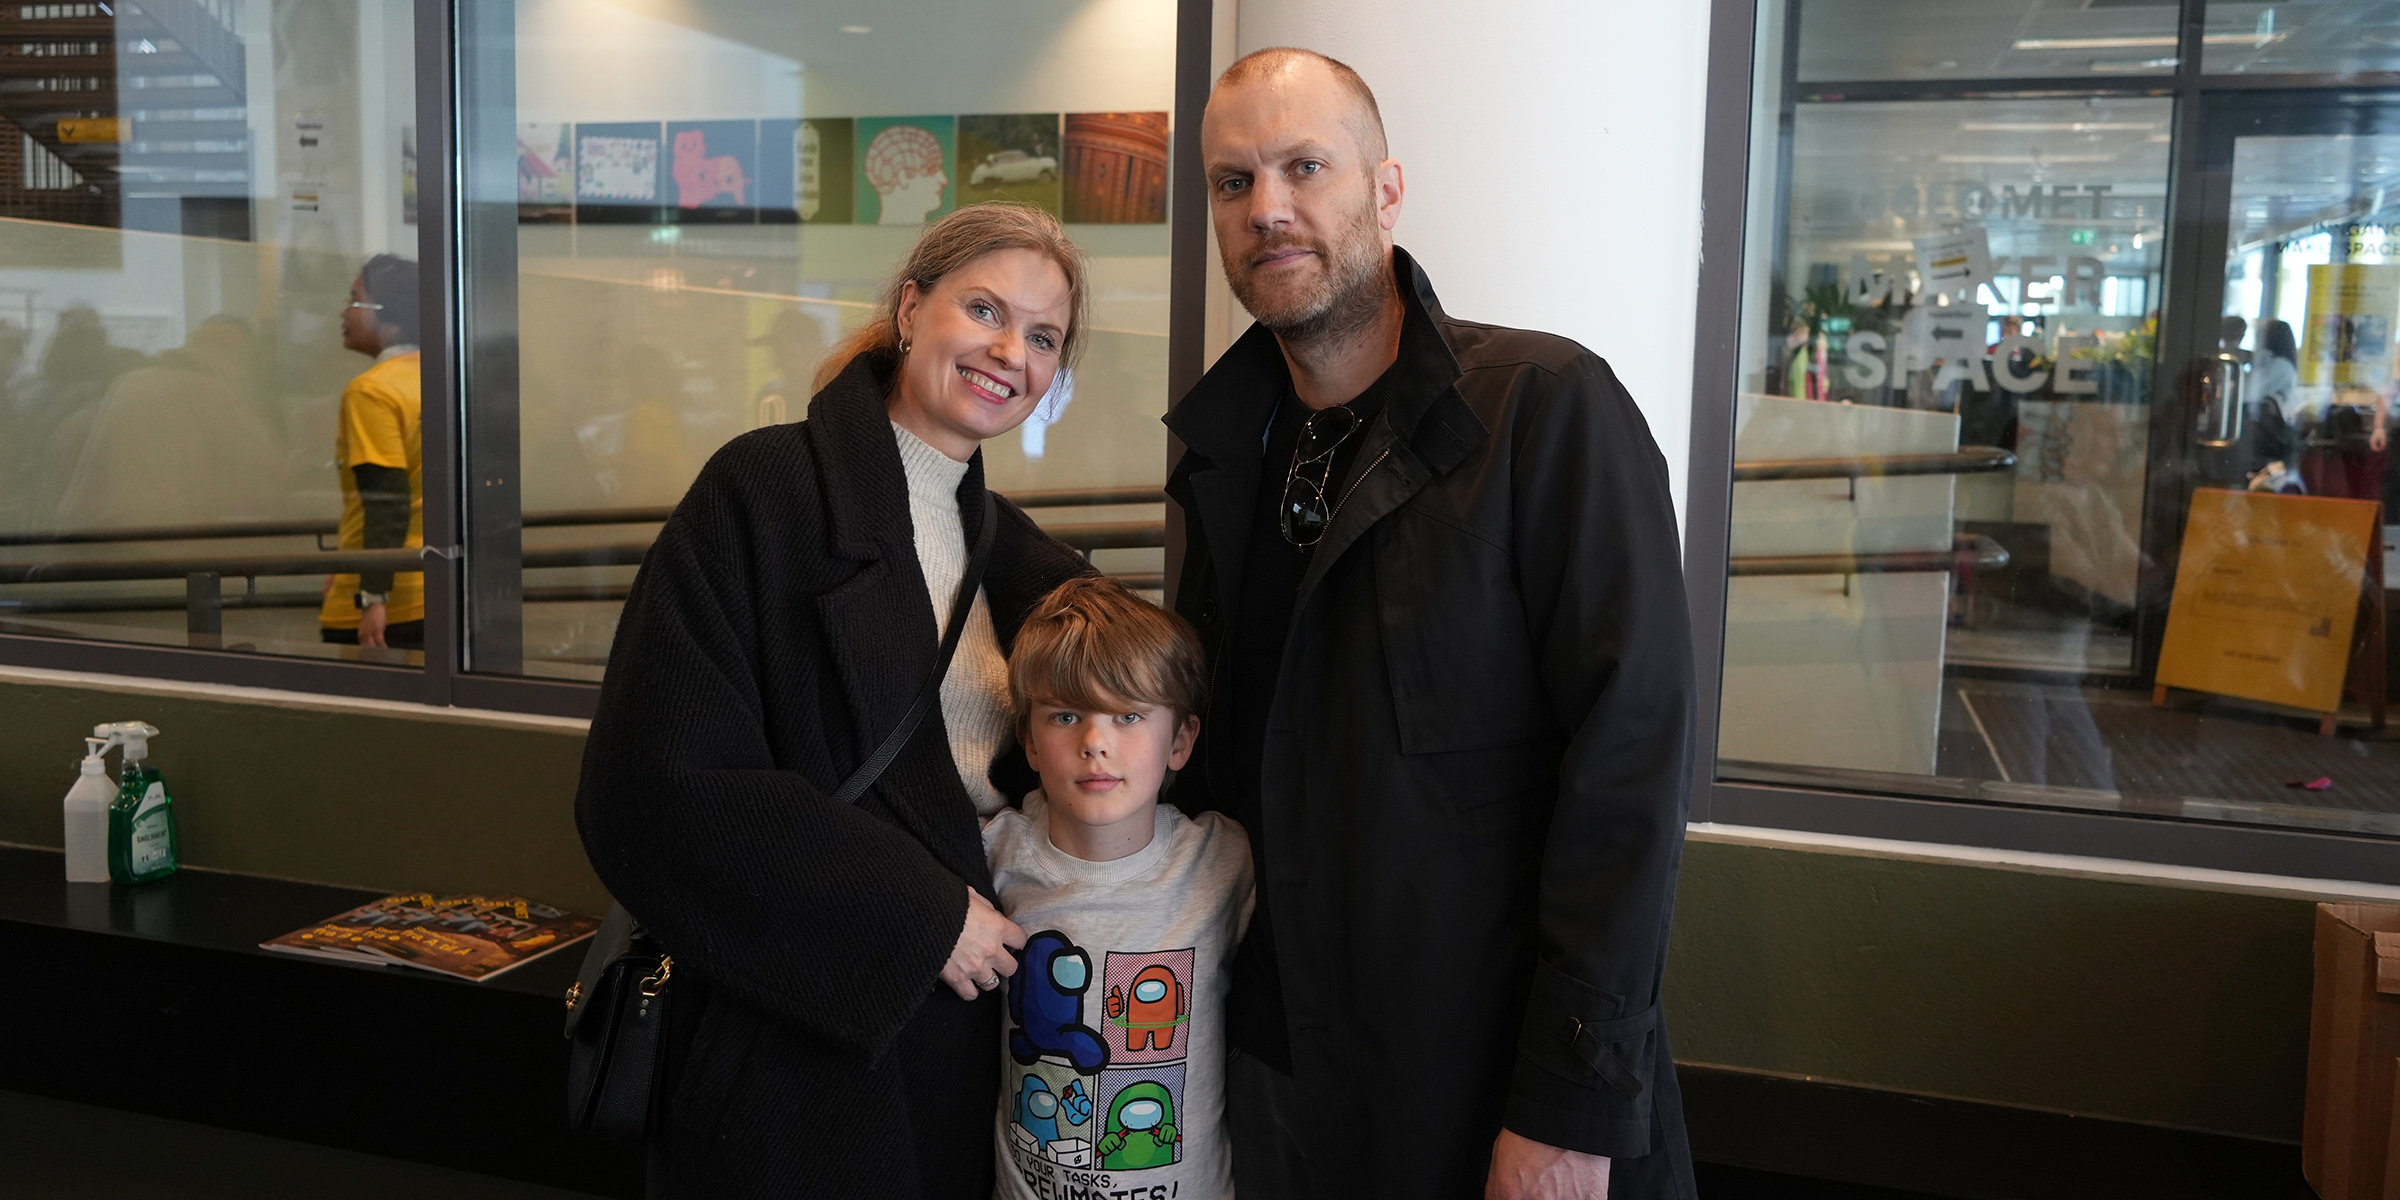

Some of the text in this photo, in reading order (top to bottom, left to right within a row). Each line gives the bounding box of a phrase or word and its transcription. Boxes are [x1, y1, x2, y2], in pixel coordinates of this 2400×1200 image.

[1849, 256, 2106, 307] MKER
[1845, 330, 2100, 394] SPACE
[1026, 1155, 1056, 1180] YOUR
[1063, 1169, 1118, 1189] TASKS,
